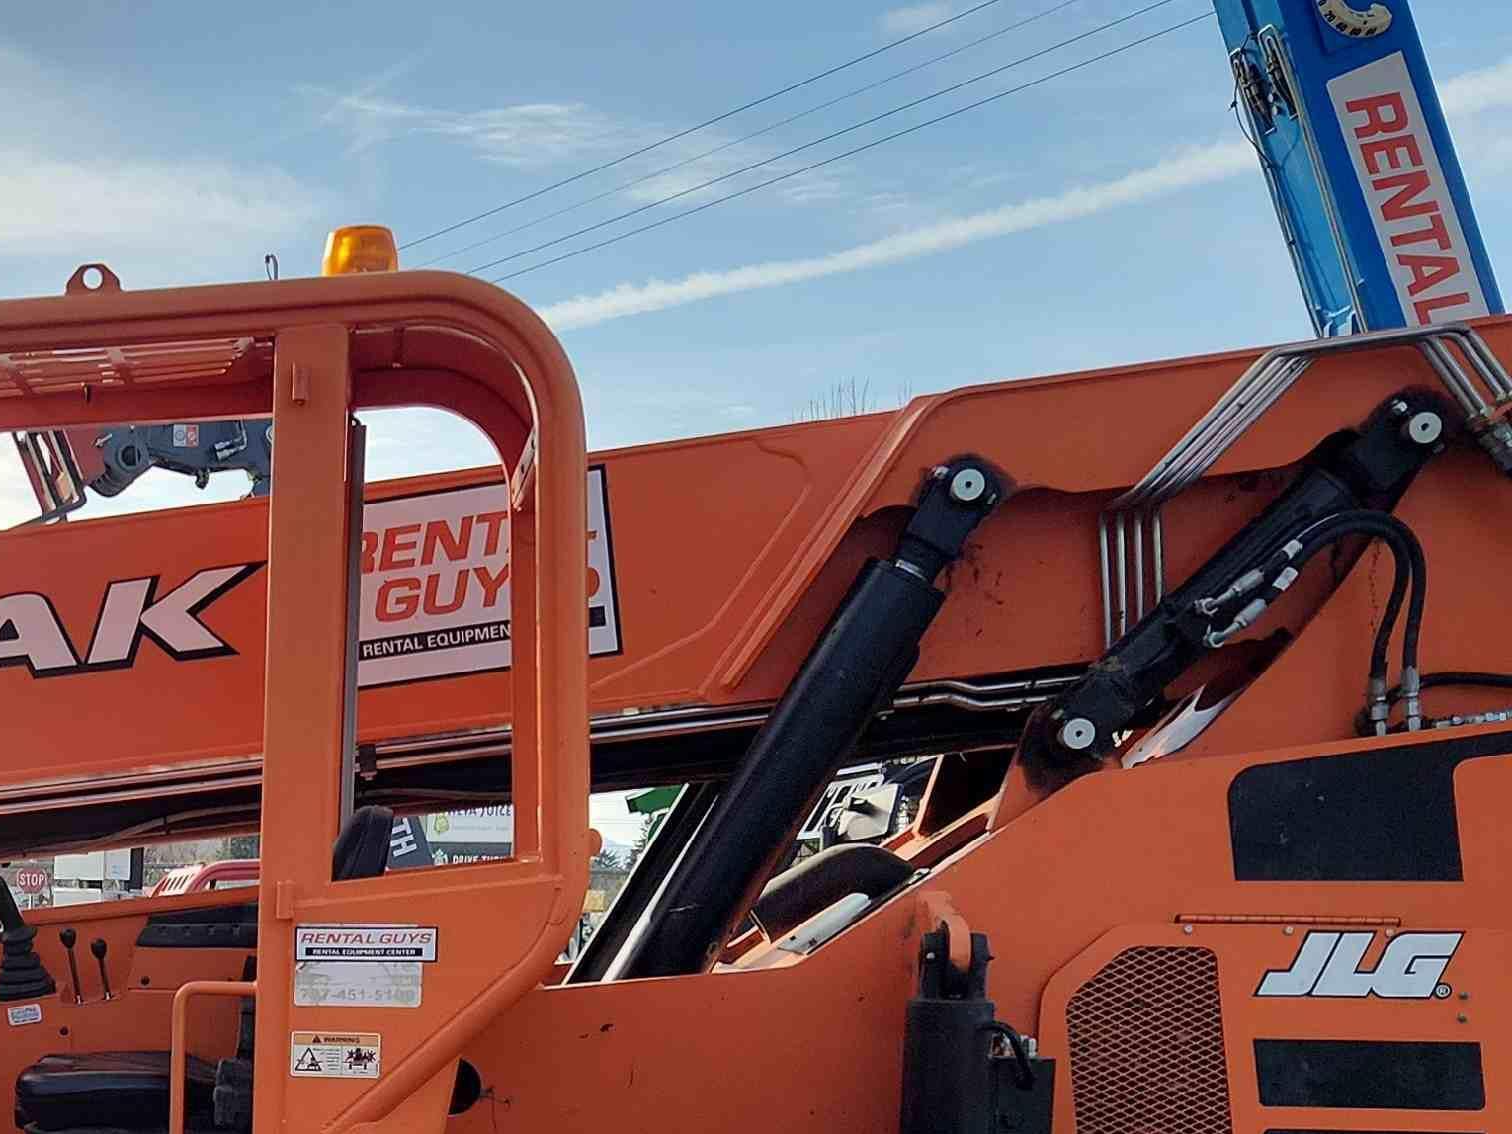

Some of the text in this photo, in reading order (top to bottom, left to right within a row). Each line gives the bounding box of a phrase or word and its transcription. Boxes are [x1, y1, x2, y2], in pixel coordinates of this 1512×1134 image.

[1345, 92, 1471, 325] RENTAL
[363, 623, 511, 657] RENTAL EQUIPMEN
[19, 873, 45, 885] STOP
[300, 932, 433, 944] RENTAL GUYS
[1254, 930, 1465, 999] JLG
